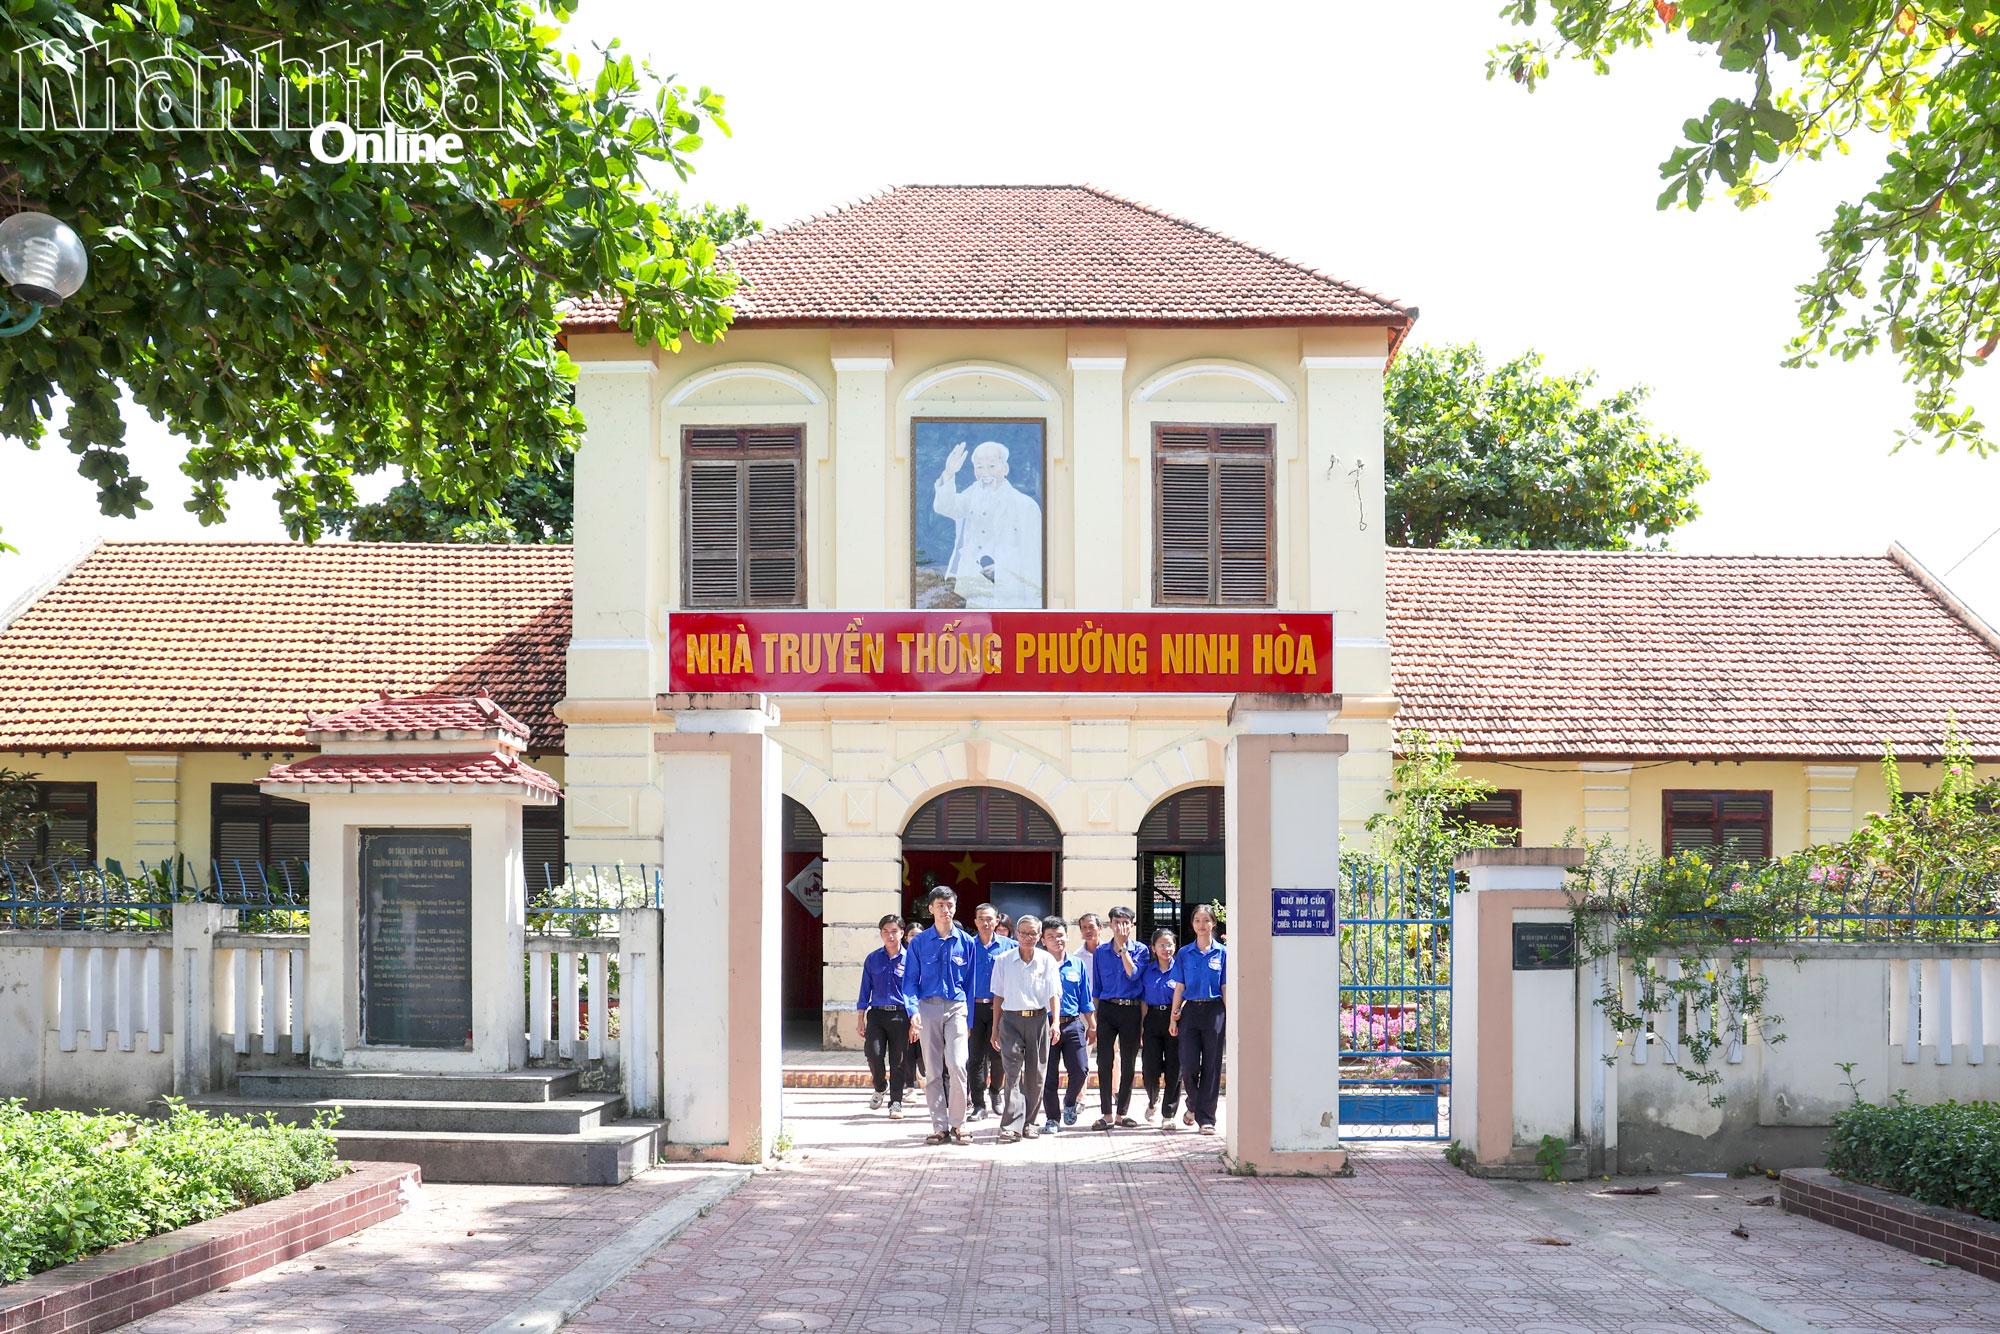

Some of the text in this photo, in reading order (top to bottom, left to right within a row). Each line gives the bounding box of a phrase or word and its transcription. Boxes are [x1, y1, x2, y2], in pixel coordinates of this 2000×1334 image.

[686, 617, 1317, 674] NHÀ TRUYỀN THỐNG PHƯỜNG NINH HÒA
[1296, 894, 1308, 904] MỞ
[1310, 894, 1325, 904] CỬA
